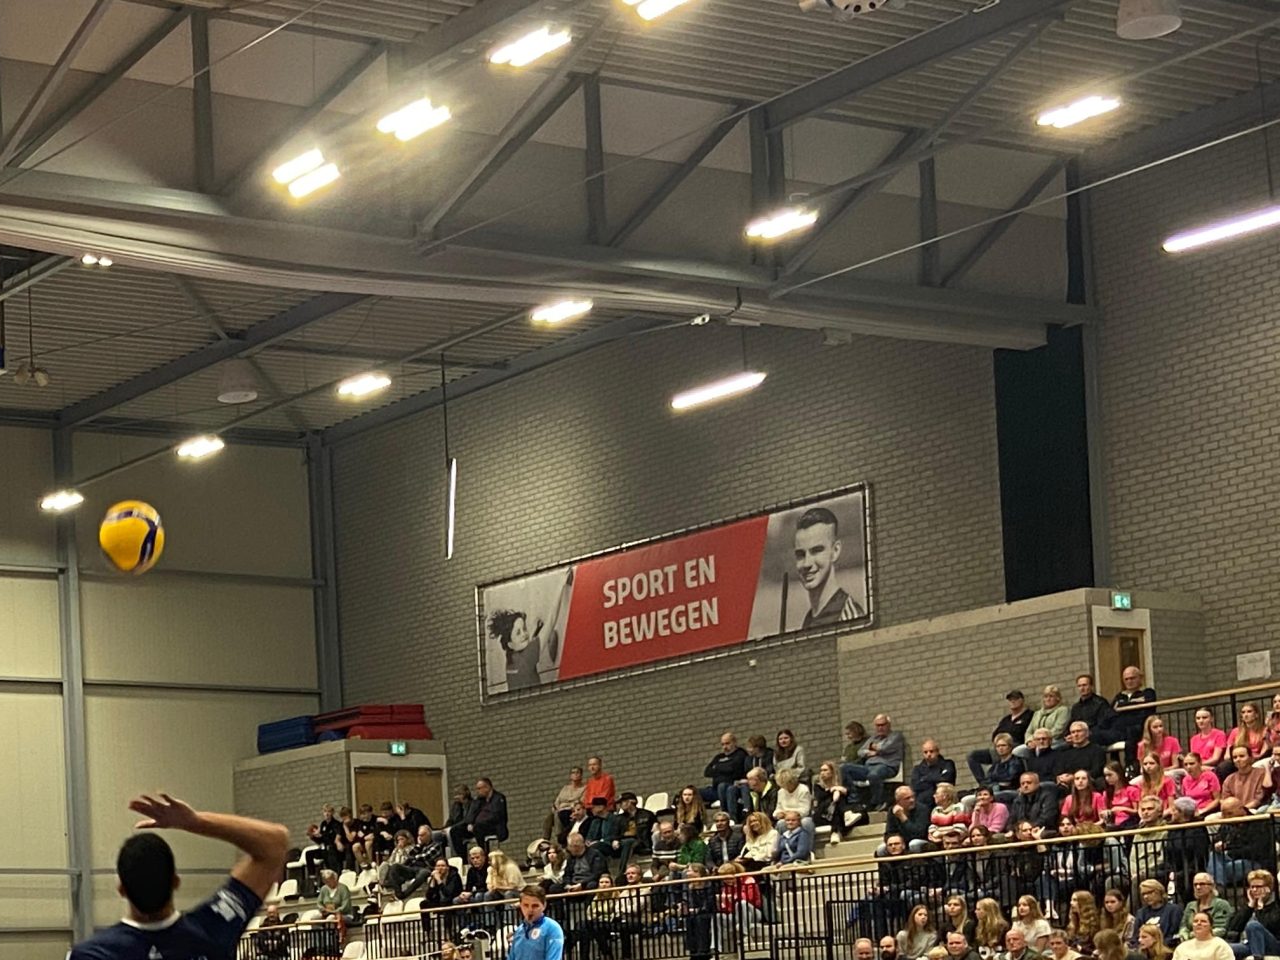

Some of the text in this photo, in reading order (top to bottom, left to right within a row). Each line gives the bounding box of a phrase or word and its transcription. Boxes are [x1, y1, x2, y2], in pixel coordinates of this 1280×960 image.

[603, 555, 716, 609] SPORT EN
[603, 597, 719, 649] BEWEGEN
